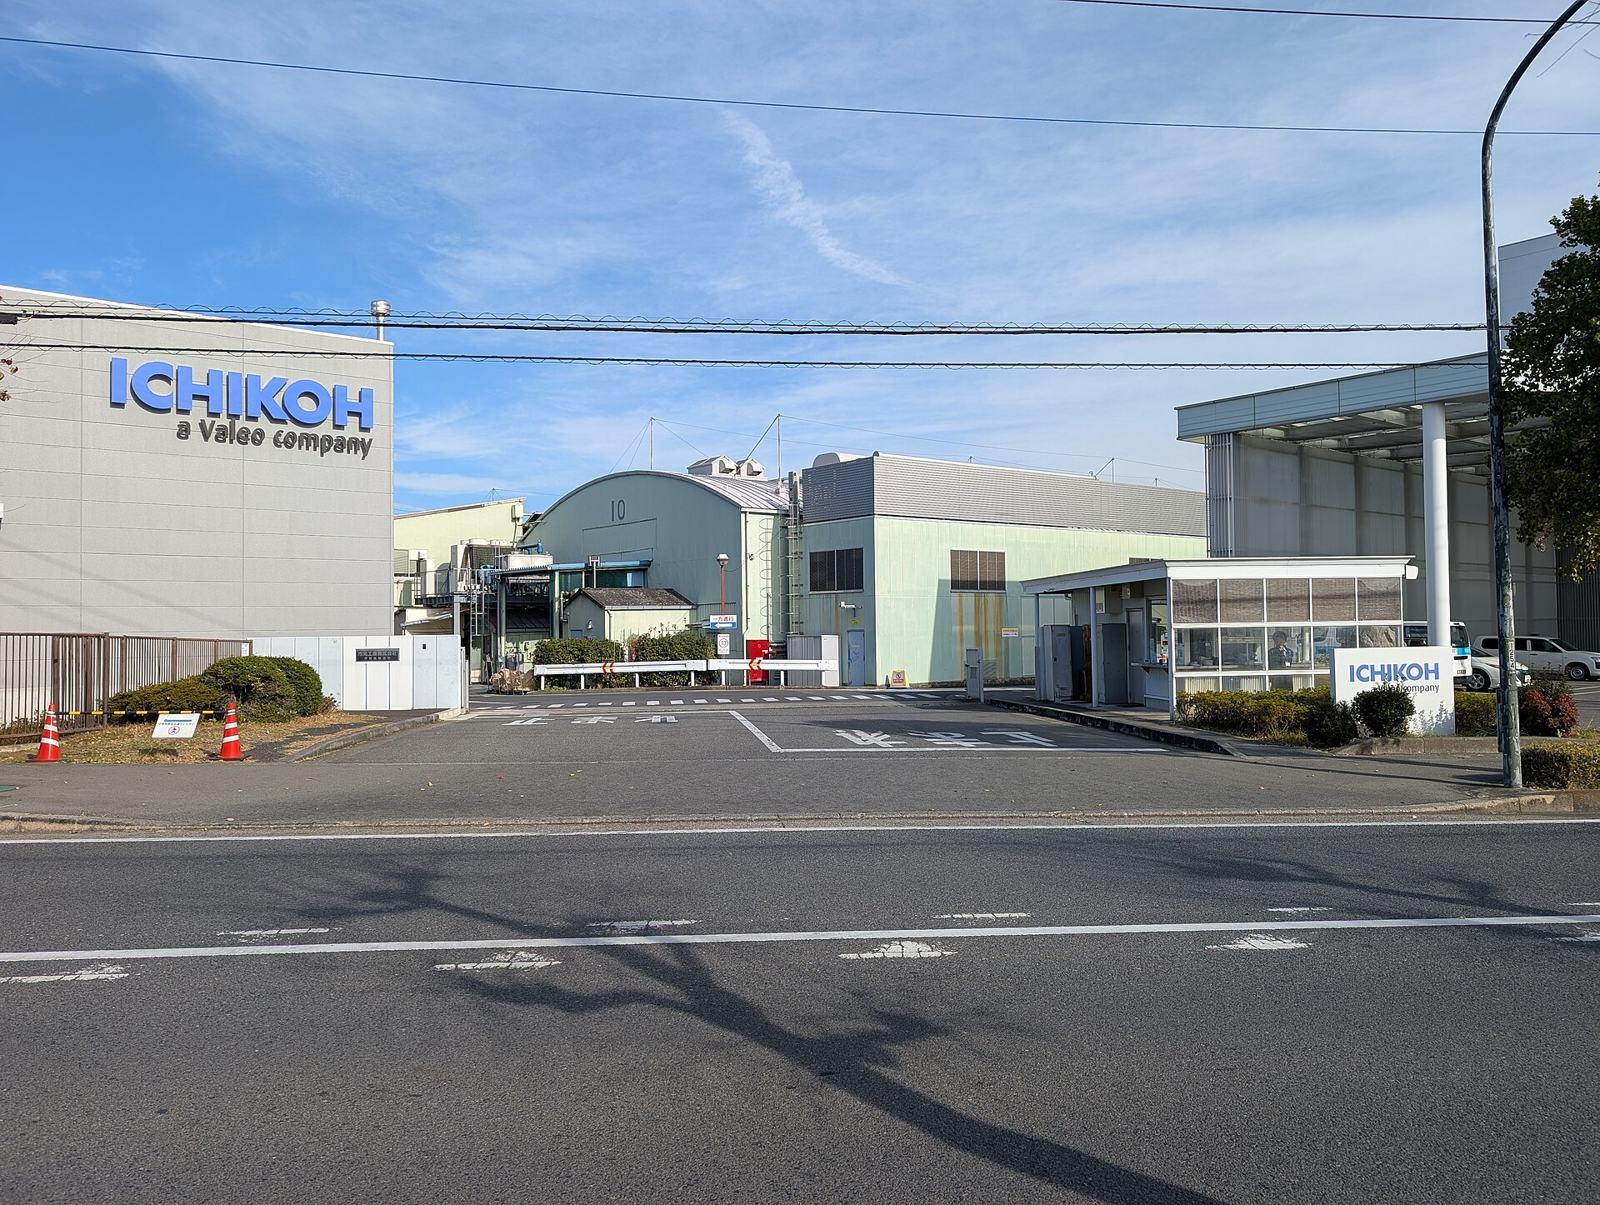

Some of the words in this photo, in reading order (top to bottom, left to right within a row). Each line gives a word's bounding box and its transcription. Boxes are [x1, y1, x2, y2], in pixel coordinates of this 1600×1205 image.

[110, 357, 374, 431] ICHIKOH
[177, 420, 191, 440] a
[199, 418, 266, 446] Valeo
[273, 429, 373, 460] company
[611, 499, 626, 521] 10
[1349, 662, 1440, 682] ICHIKOH
[833, 728, 1058, 748] 止まれ
